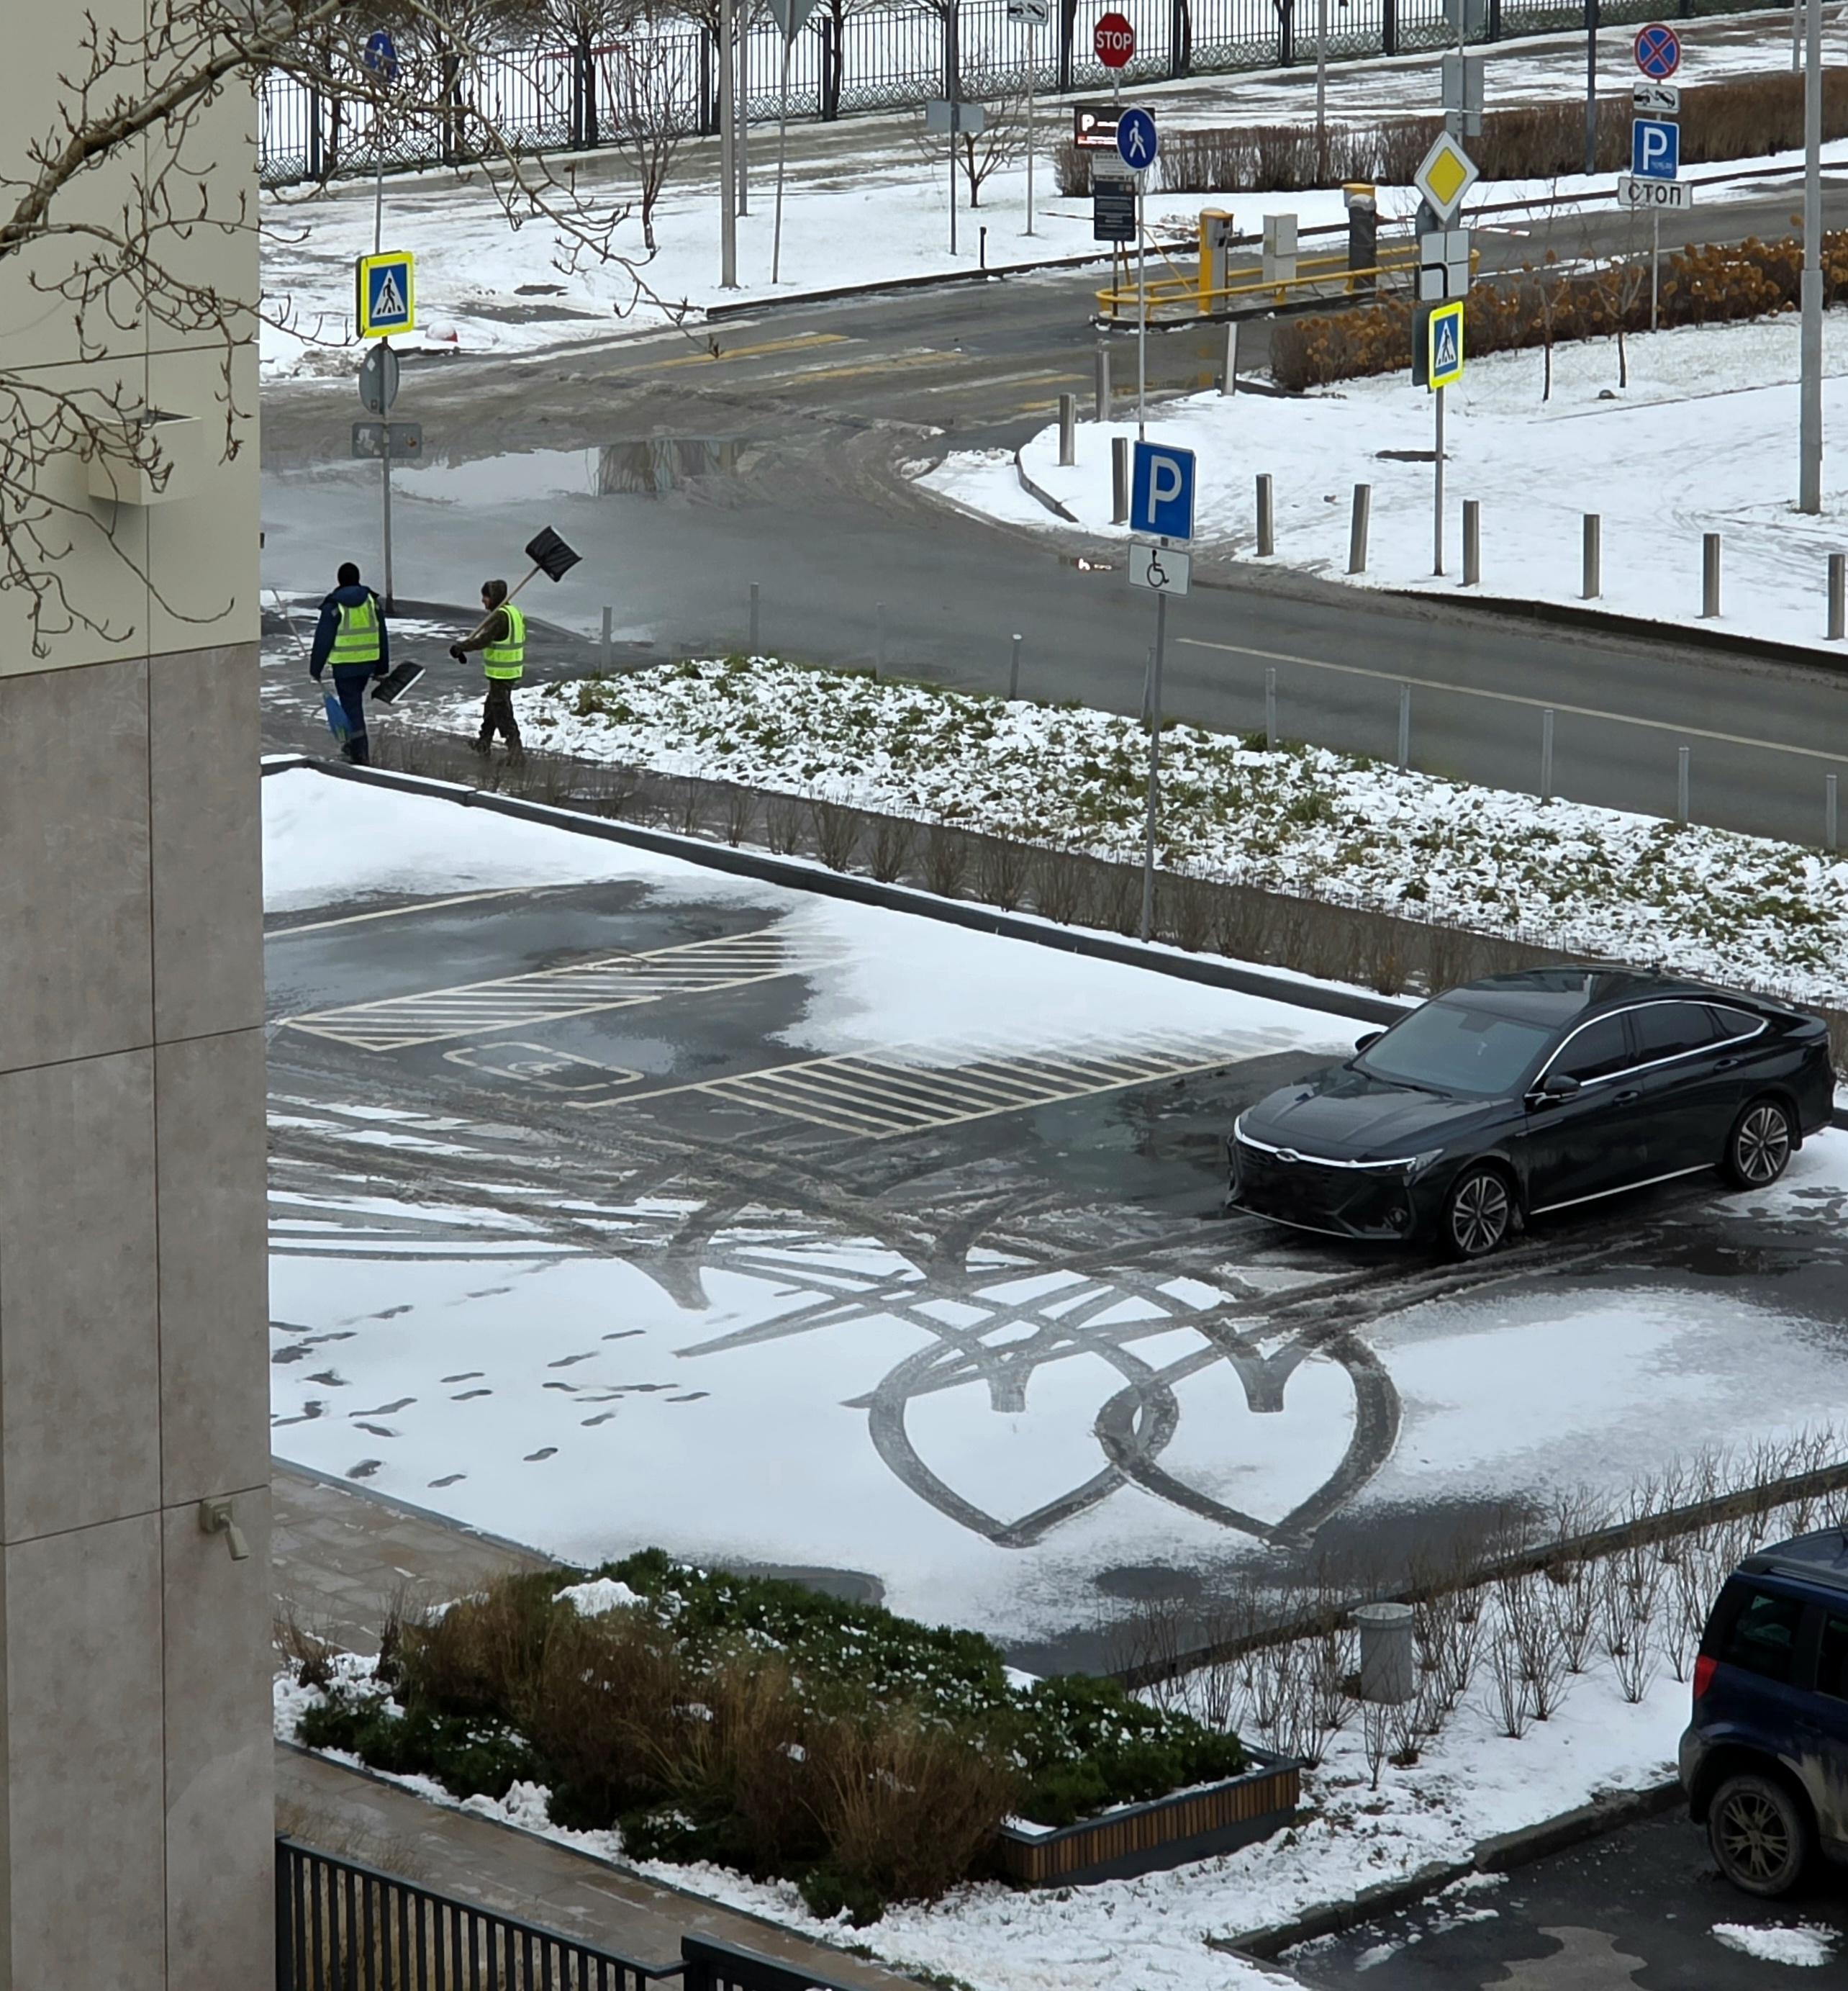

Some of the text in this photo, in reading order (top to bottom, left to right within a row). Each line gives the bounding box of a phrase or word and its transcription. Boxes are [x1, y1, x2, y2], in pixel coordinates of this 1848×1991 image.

[1096, 30, 1132, 51] STOP
[1082, 114, 1095, 131] P
[1643, 126, 1667, 171] P
[1628, 182, 1681, 206] СТОП
[1148, 454, 1182, 524] P
